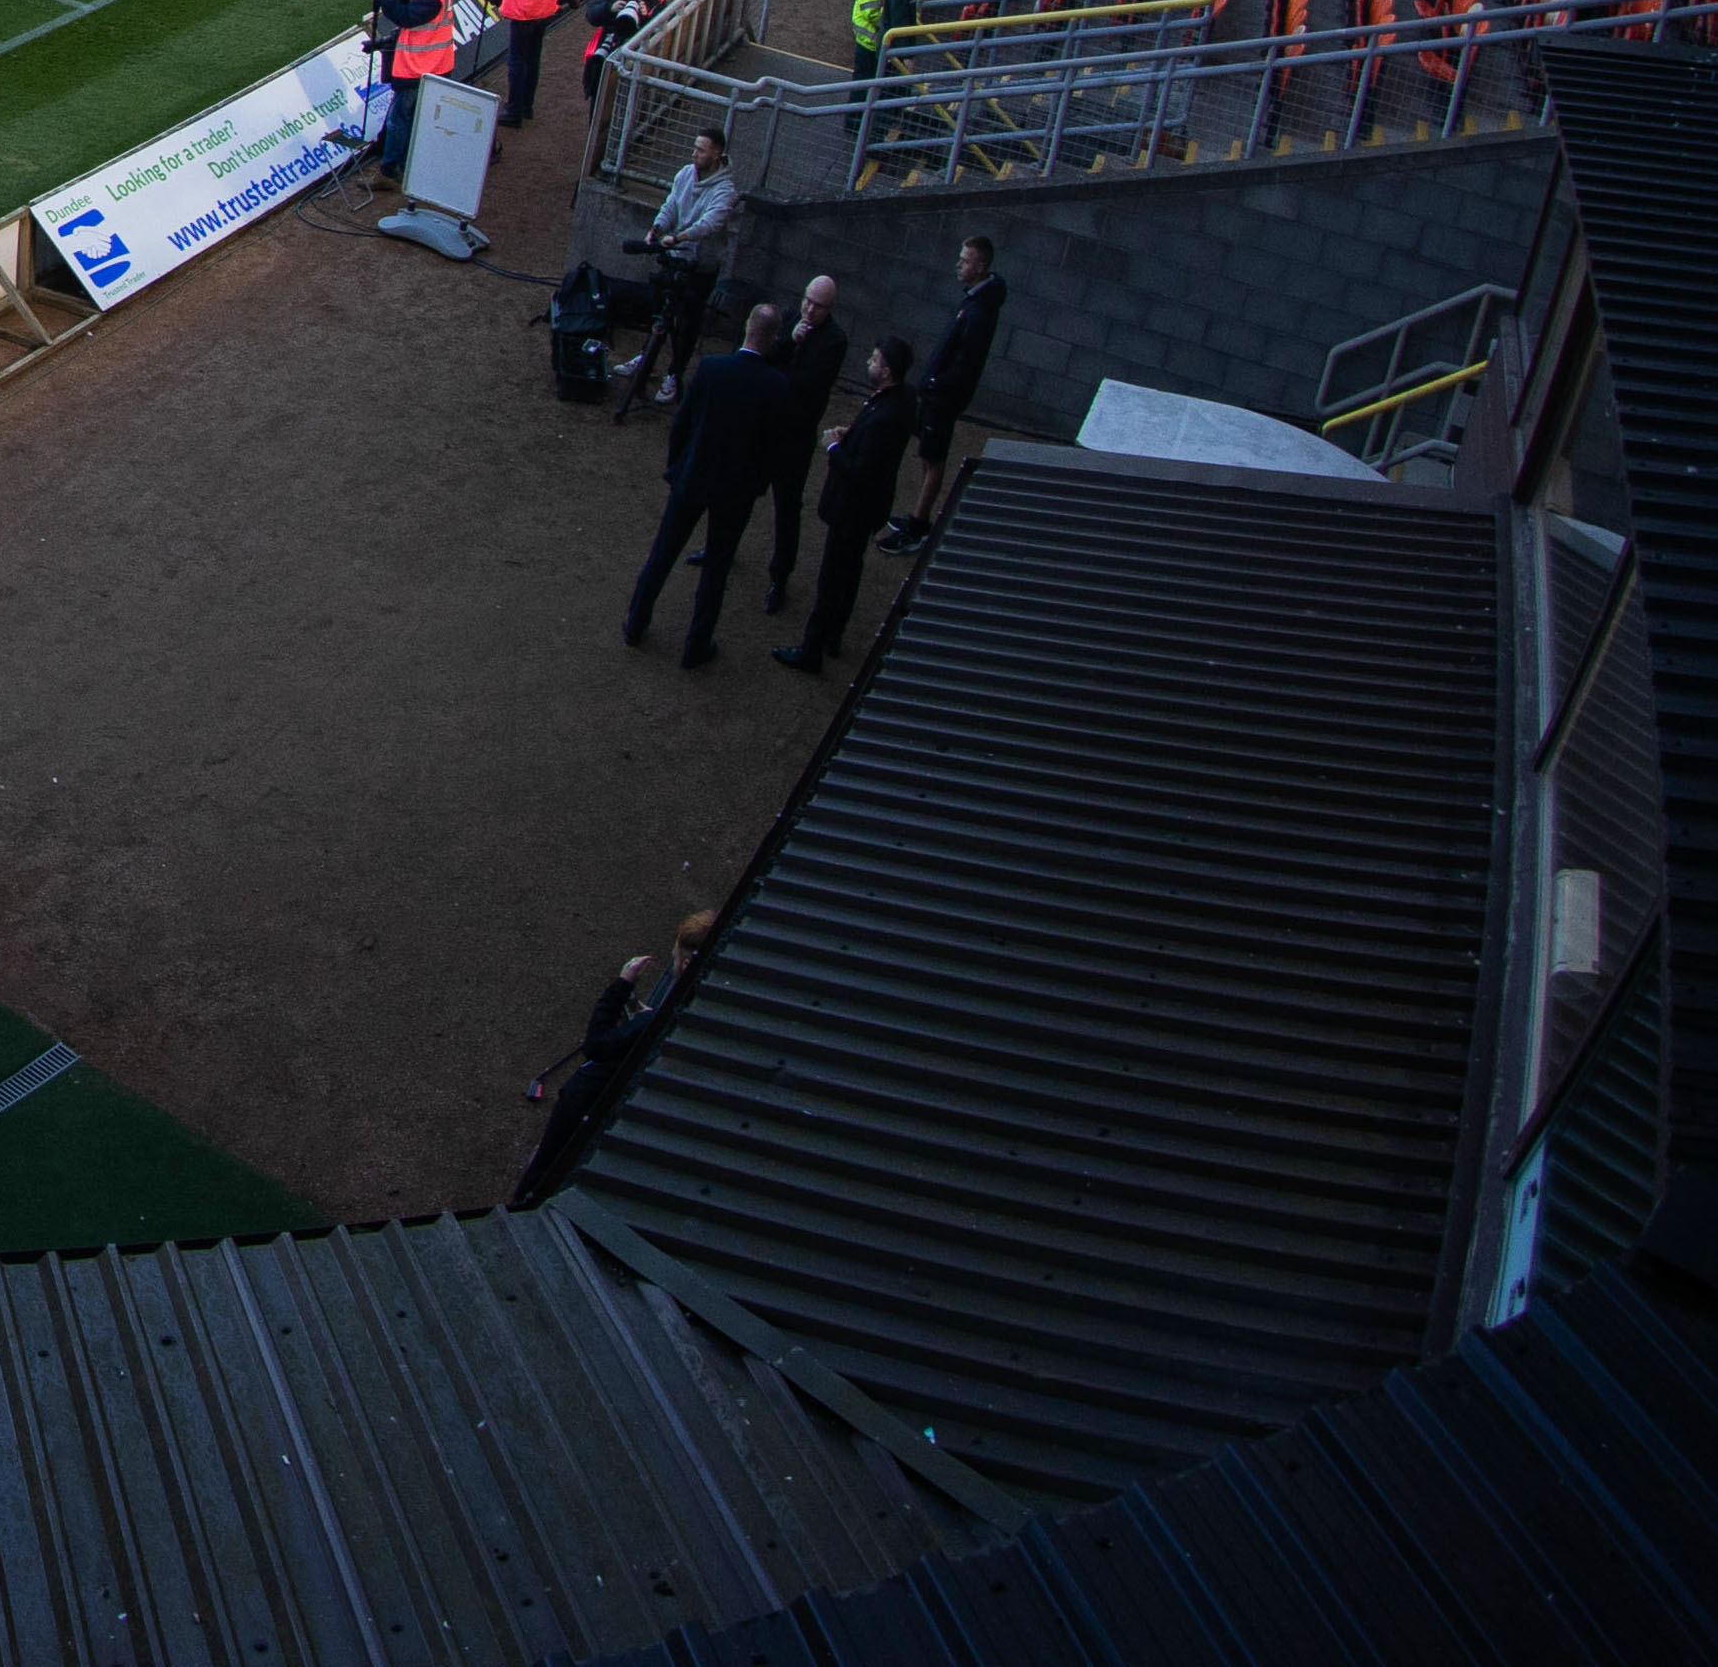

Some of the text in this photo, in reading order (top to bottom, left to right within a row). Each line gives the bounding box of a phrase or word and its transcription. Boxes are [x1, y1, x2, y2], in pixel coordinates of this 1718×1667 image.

[105, 119, 239, 203] Looking for a trader?
[207, 89, 349, 180] Don't know who to trust?
[44, 192, 92, 226] Dundee
[102, 269, 147, 301] Trusted Trader
